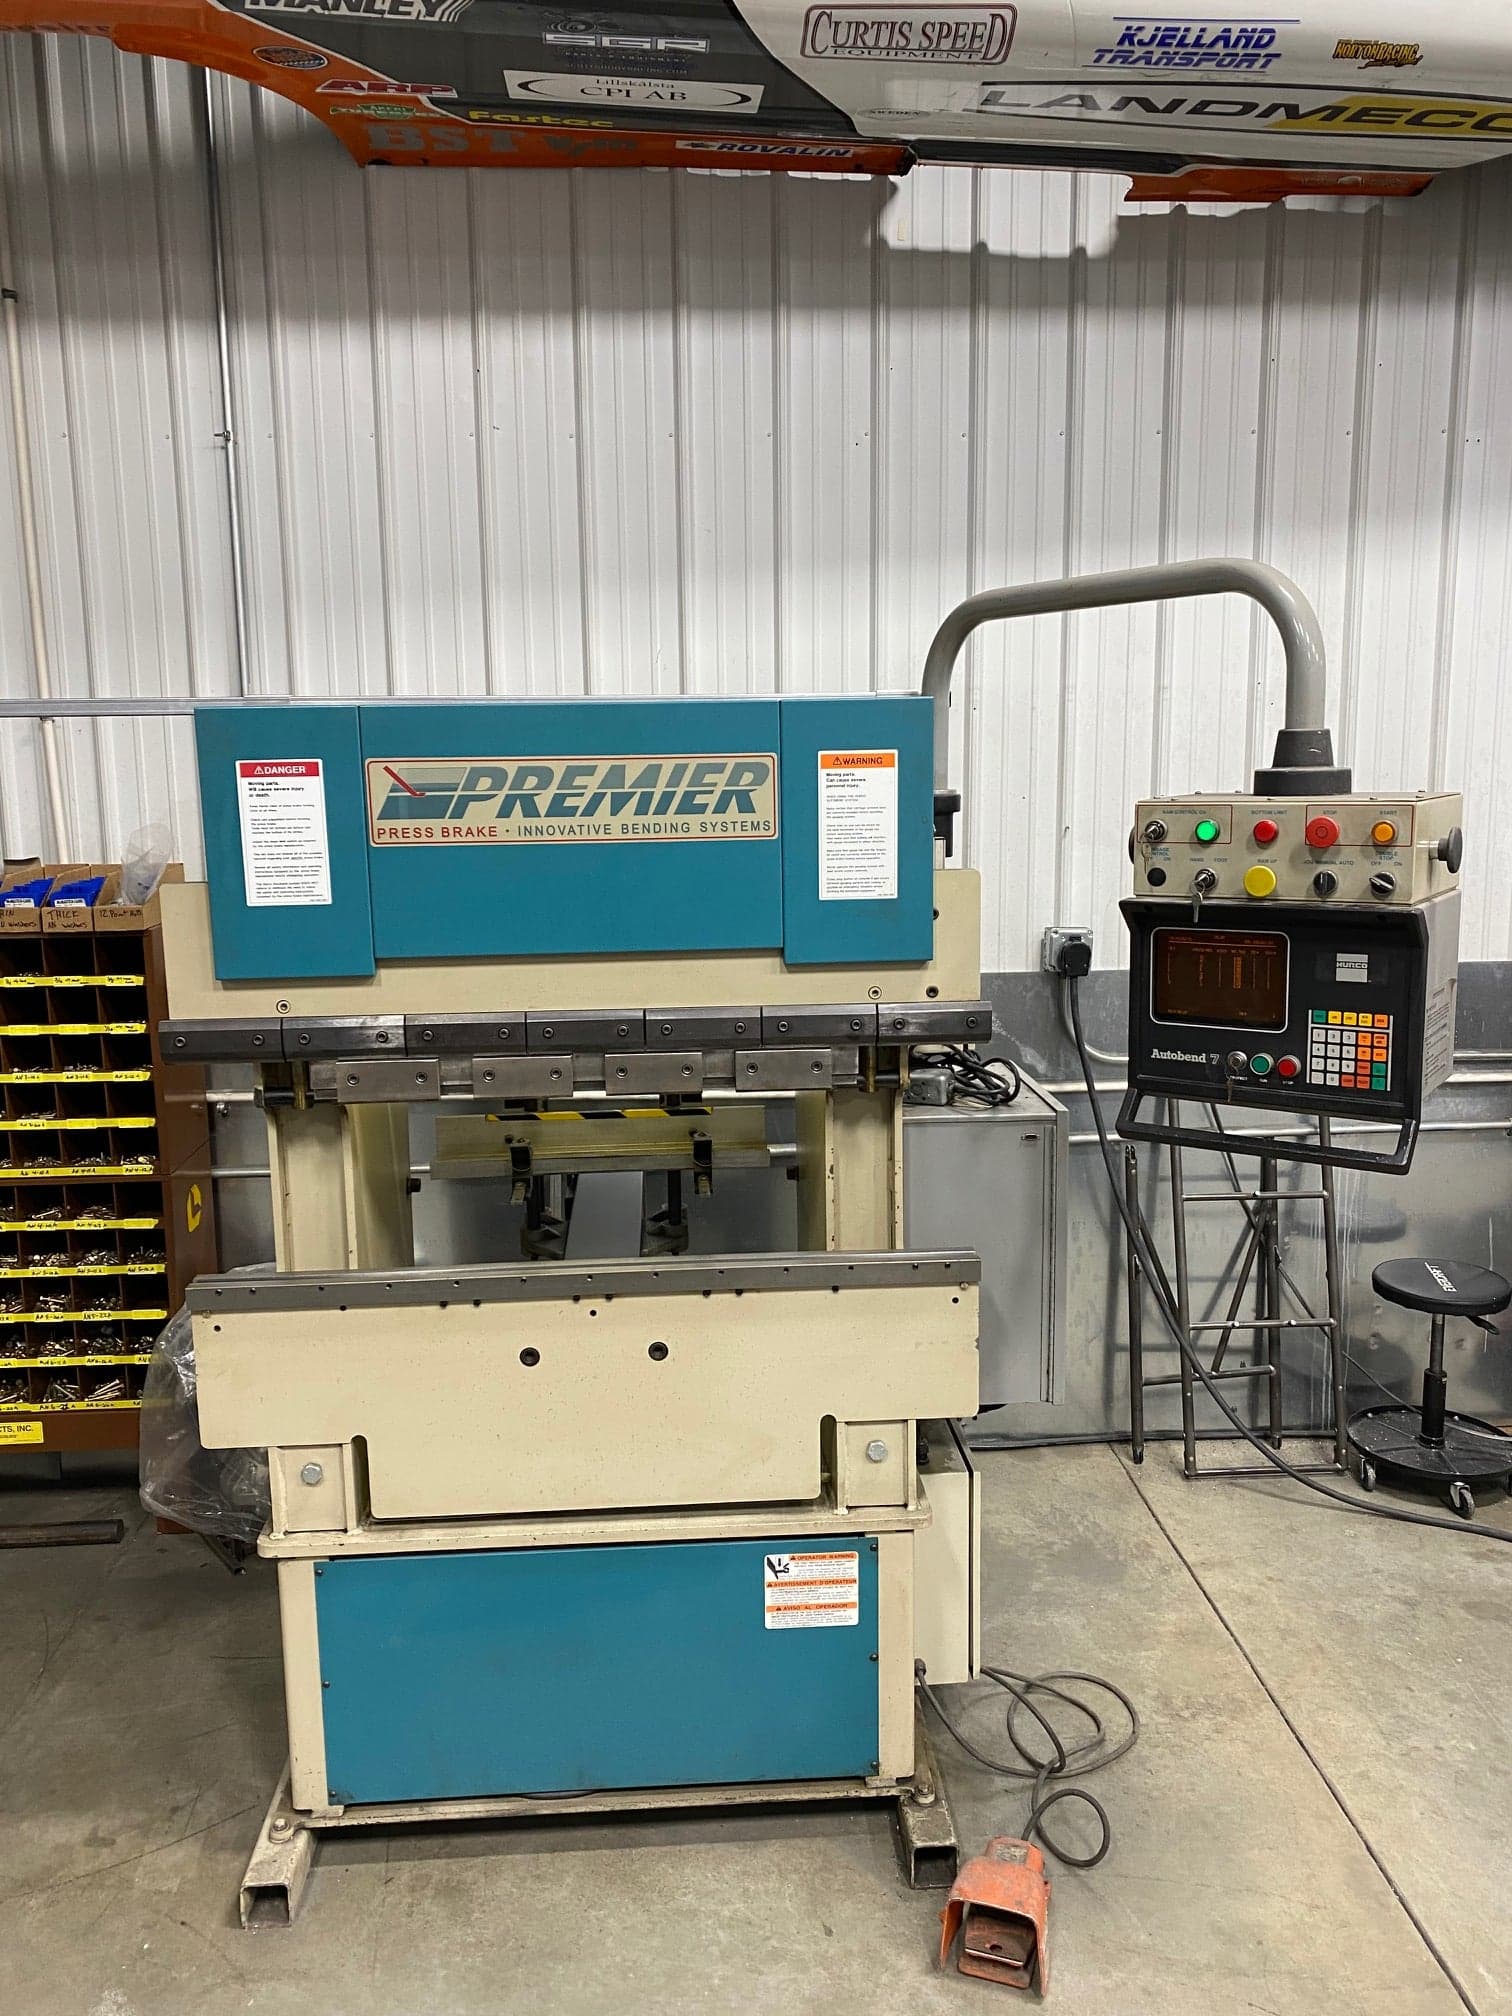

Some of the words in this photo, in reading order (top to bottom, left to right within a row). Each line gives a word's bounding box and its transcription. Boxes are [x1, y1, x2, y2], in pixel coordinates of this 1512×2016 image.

[245, 0, 452, 21] MANLEY
[811, 11, 912, 54] CURTIS
[919, 14, 1008, 61] SPEED
[1117, 25, 1277, 49] KJELLAND
[833, 49, 981, 61] EQUIPMENT
[1092, 49, 1281, 70] TRANSPORT
[318, 79, 456, 96] ARP
[715, 141, 851, 157] ROVALIN
[843, 756, 883, 765] WARNING
[264, 766, 306, 775] DANGER
[448, 761, 770, 819] PREMIER
[377, 826, 434, 840] PRESS
[441, 825, 498, 839] BRAKE
[517, 824, 612, 837] INNOVATIVE
[620, 822, 691, 835] BENDING
[699, 820, 771, 833] SYSTEMS
[1336, 961, 1368, 969] HURCO
[1151, 1049, 1206, 1063] Autobend
[1210, 1053, 1220, 1064] 7
[16, 1424, 34, 1432] INC.
